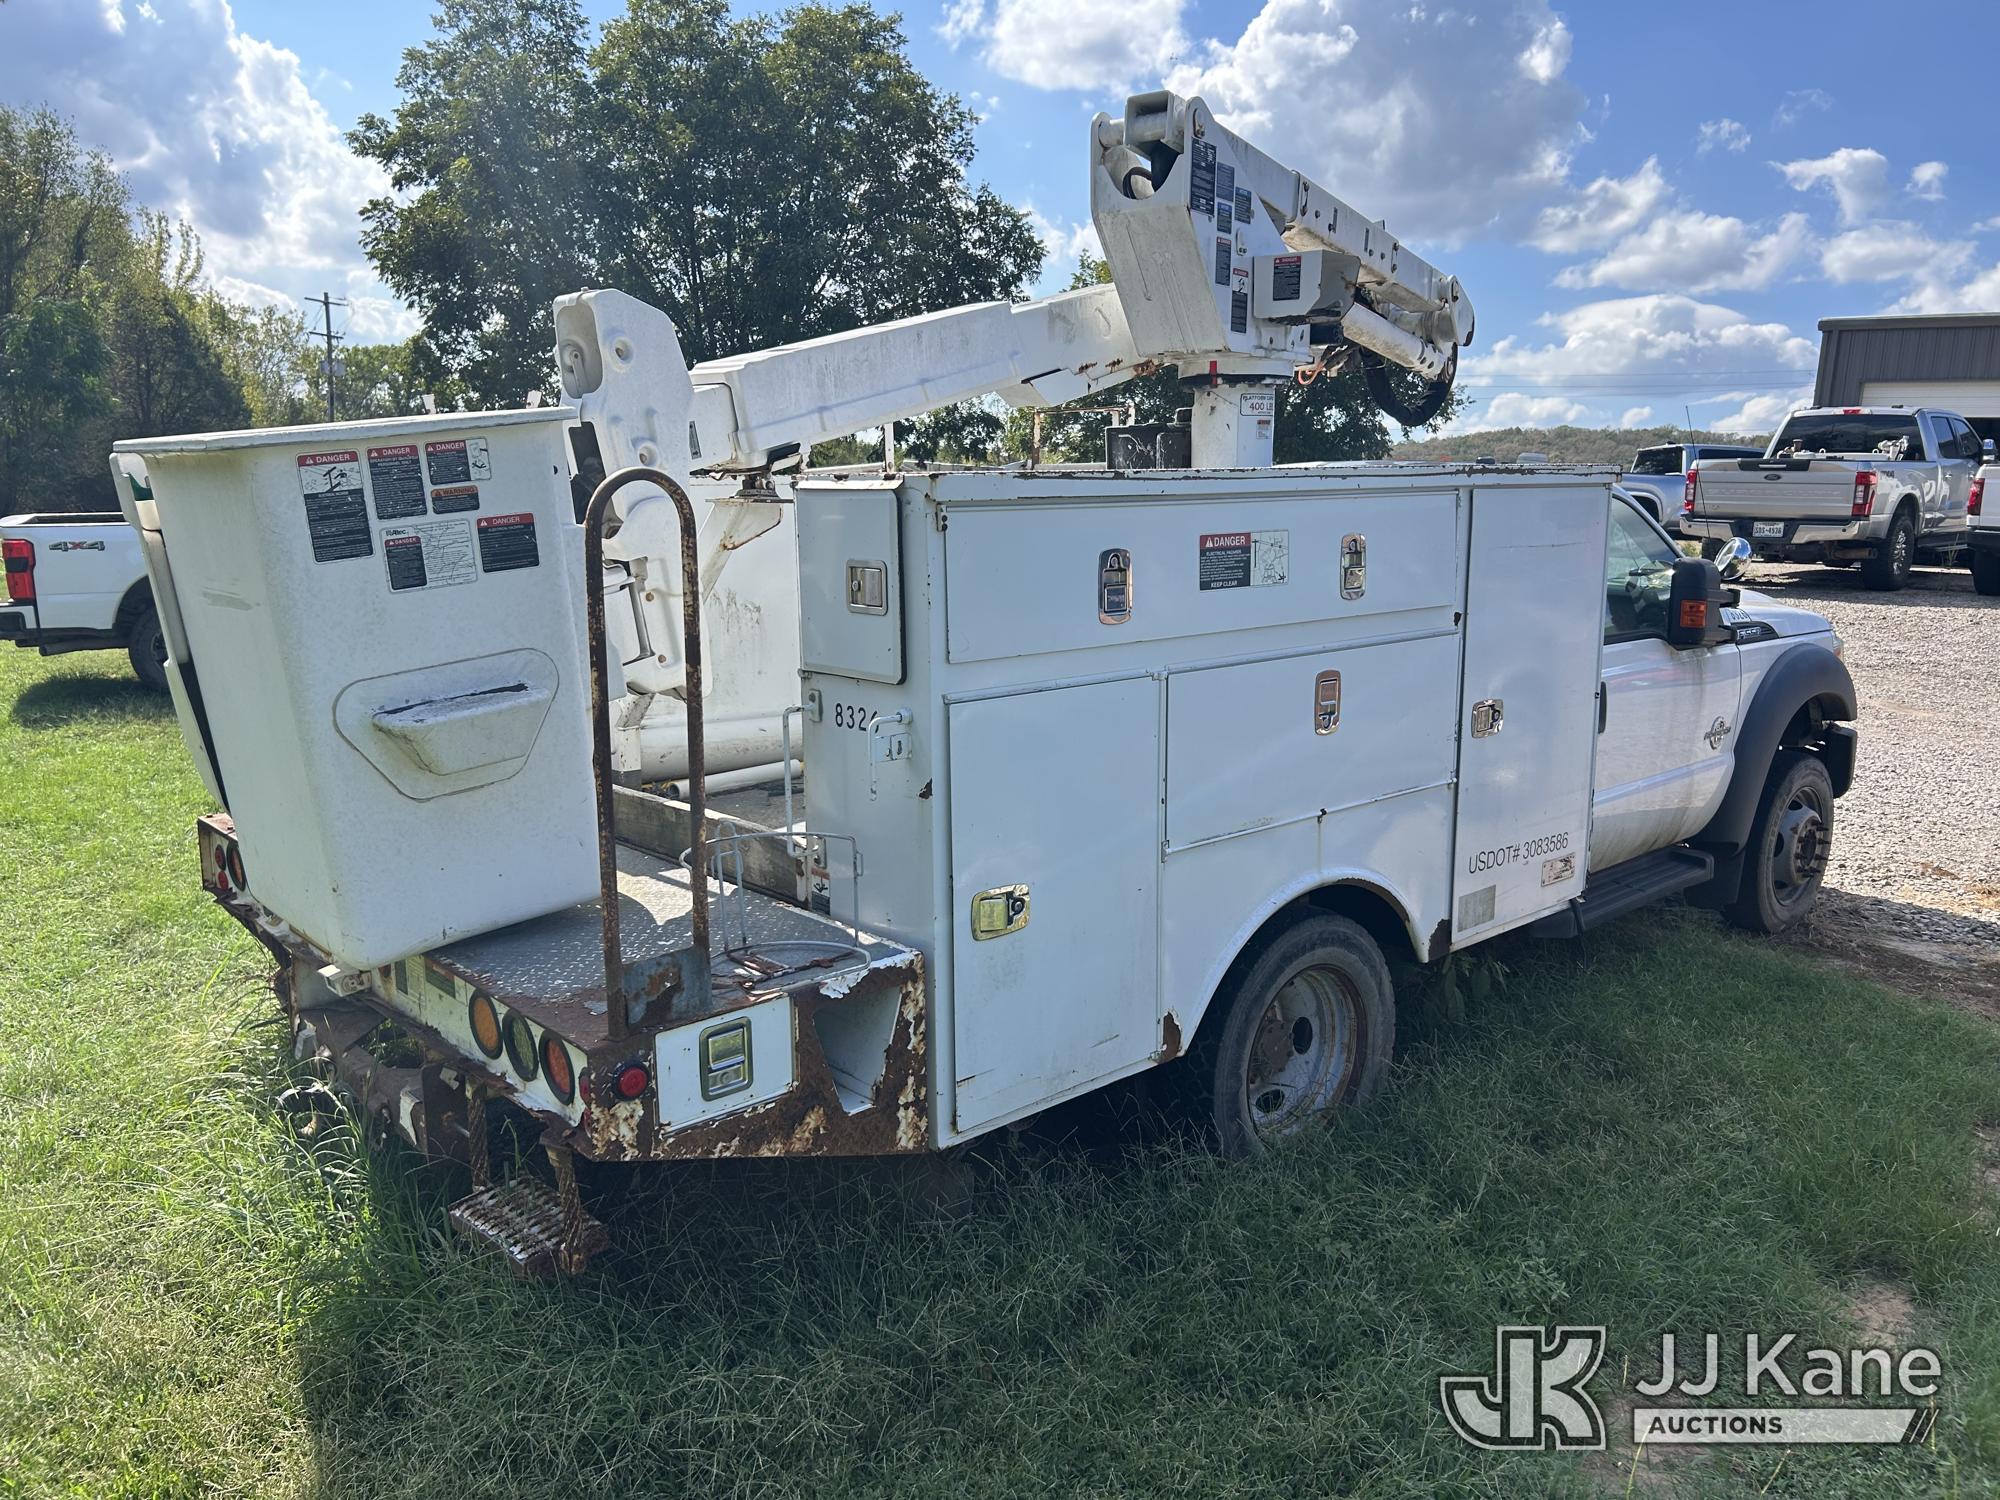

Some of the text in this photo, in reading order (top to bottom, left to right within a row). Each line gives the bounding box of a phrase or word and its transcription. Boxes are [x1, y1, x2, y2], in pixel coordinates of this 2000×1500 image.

[1250, 402, 1265, 411] 400
[435, 441, 466, 451] DANGER
[382, 447, 411, 456] DANGER
[315, 453, 351, 463] DANGER
[442, 487, 475, 496] WARNING
[492, 516, 521, 525] DANGER
[1214, 535, 1246, 547] DANGER
[1468, 843, 1521, 874] USDOT#
[1522, 832, 1569, 860] 3083586
